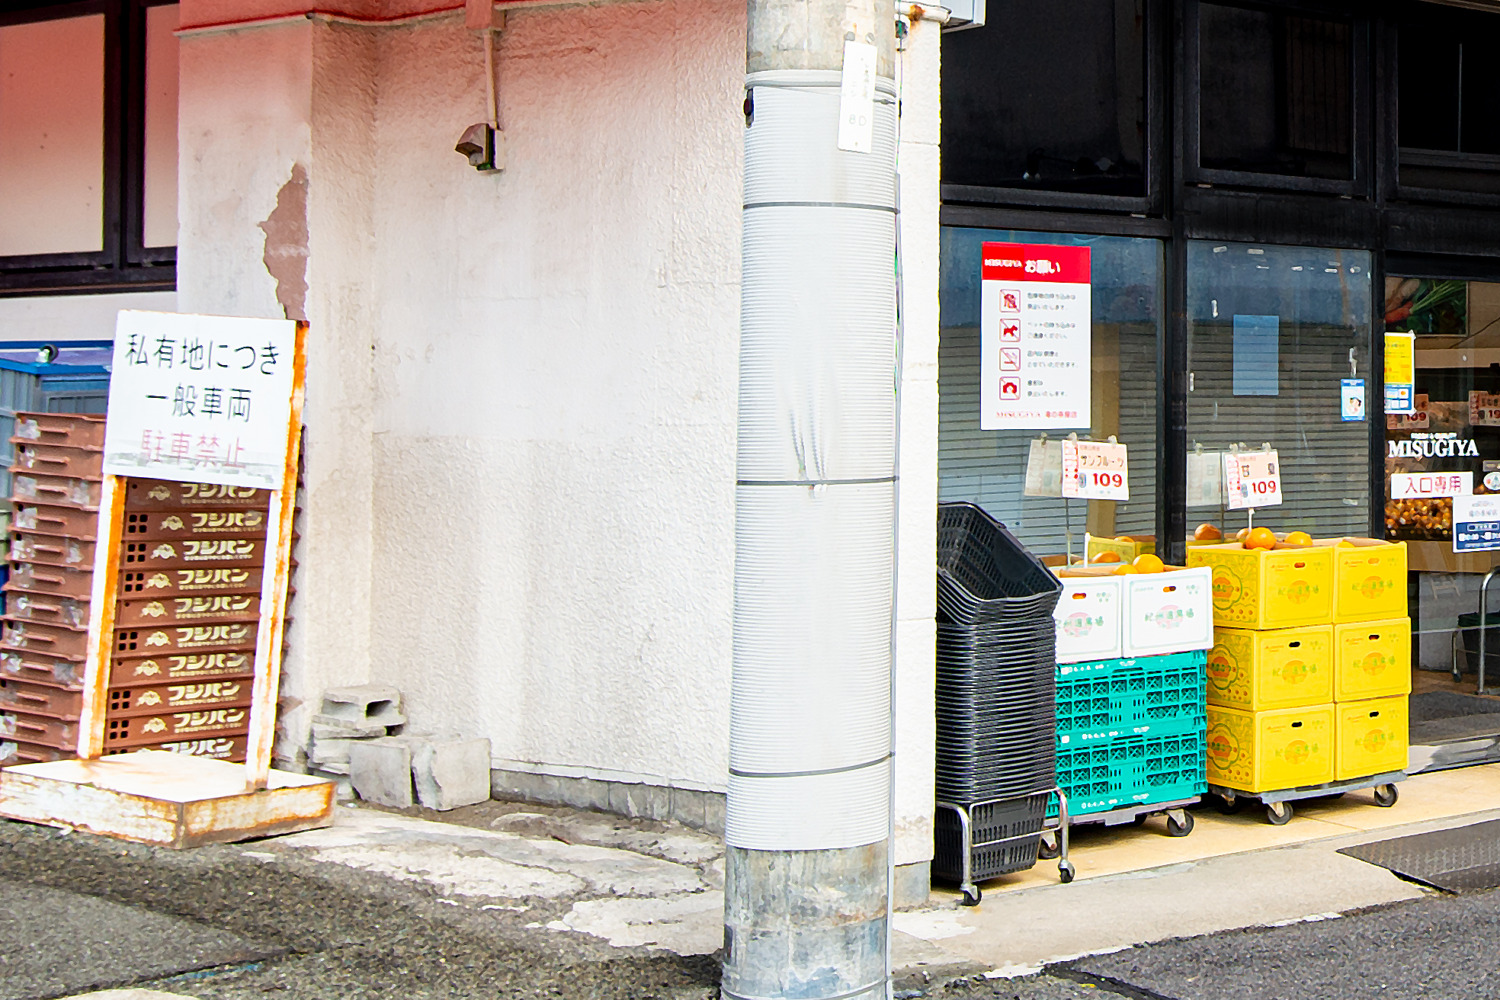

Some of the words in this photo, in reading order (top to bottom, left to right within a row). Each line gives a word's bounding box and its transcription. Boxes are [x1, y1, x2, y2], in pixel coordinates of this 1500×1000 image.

[125, 333, 279, 376] 私有地につき
[145, 382, 252, 423] 一般車両
[141, 429, 247, 468] 駐車禁止
[1388, 439, 1480, 458] MISUGIYA
[1093, 472, 1123, 488] 109
[1252, 480, 1277, 494] 109
[1405, 475, 1462, 494] 入口専用
